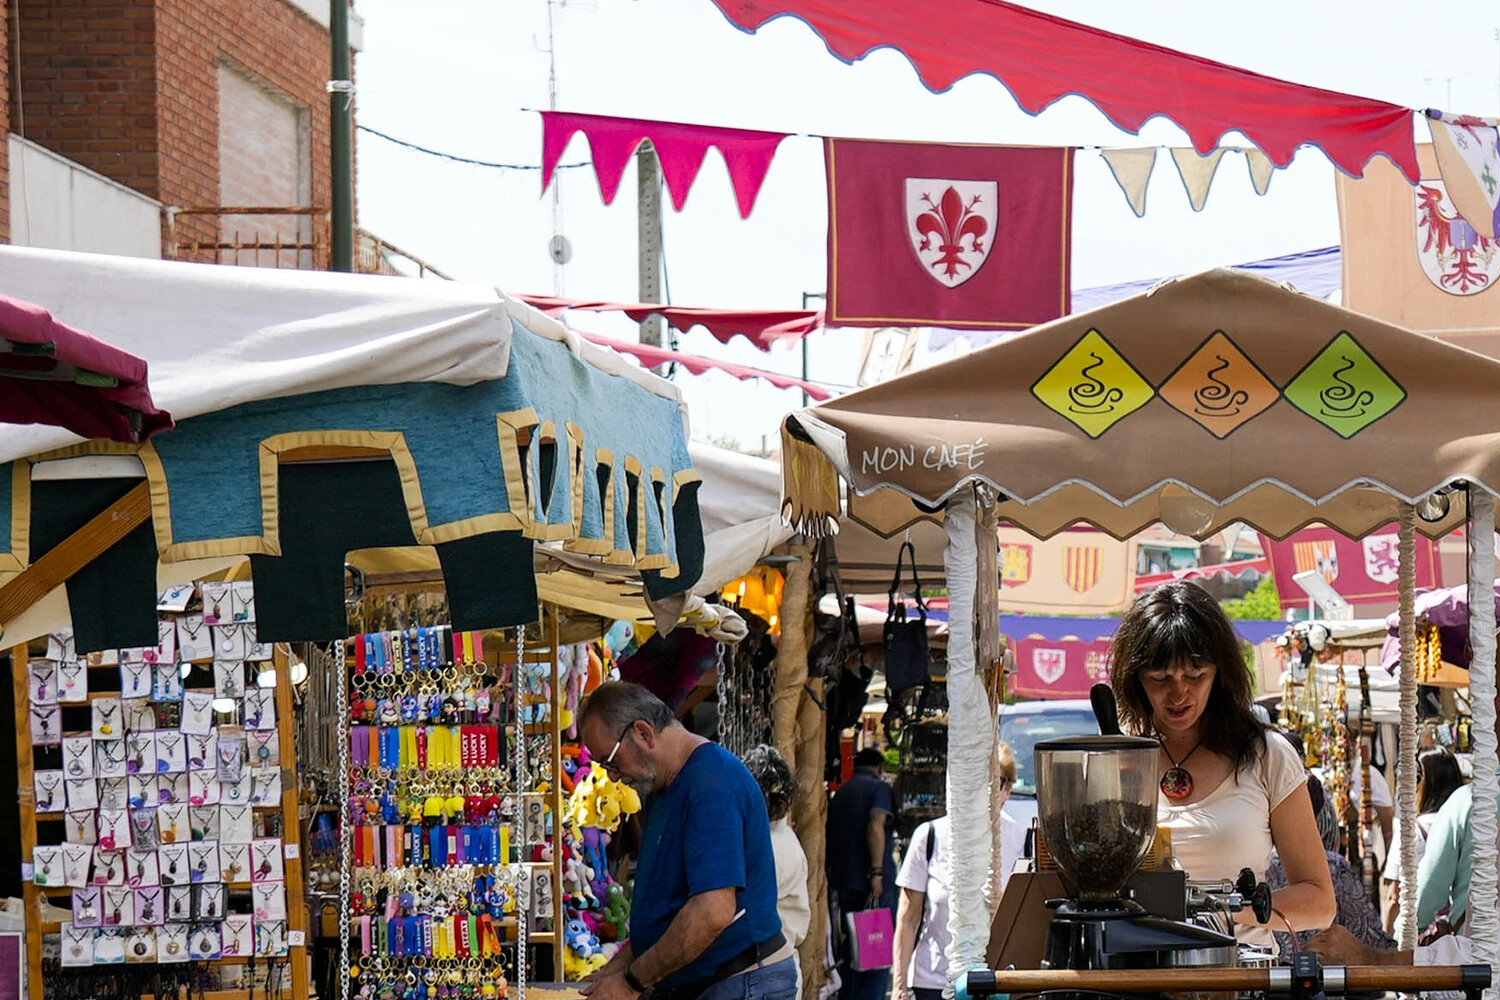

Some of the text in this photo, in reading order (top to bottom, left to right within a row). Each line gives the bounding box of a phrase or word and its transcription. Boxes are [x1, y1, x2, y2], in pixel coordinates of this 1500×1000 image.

[861, 437, 989, 475] MON CAFÉ
[418, 635, 427, 661] LUCKY
[461, 733, 469, 759] LUCKY
[470, 732, 478, 759] LUCKY
[479, 733, 487, 759] LUCKY
[412, 832, 421, 858] LUCKY
